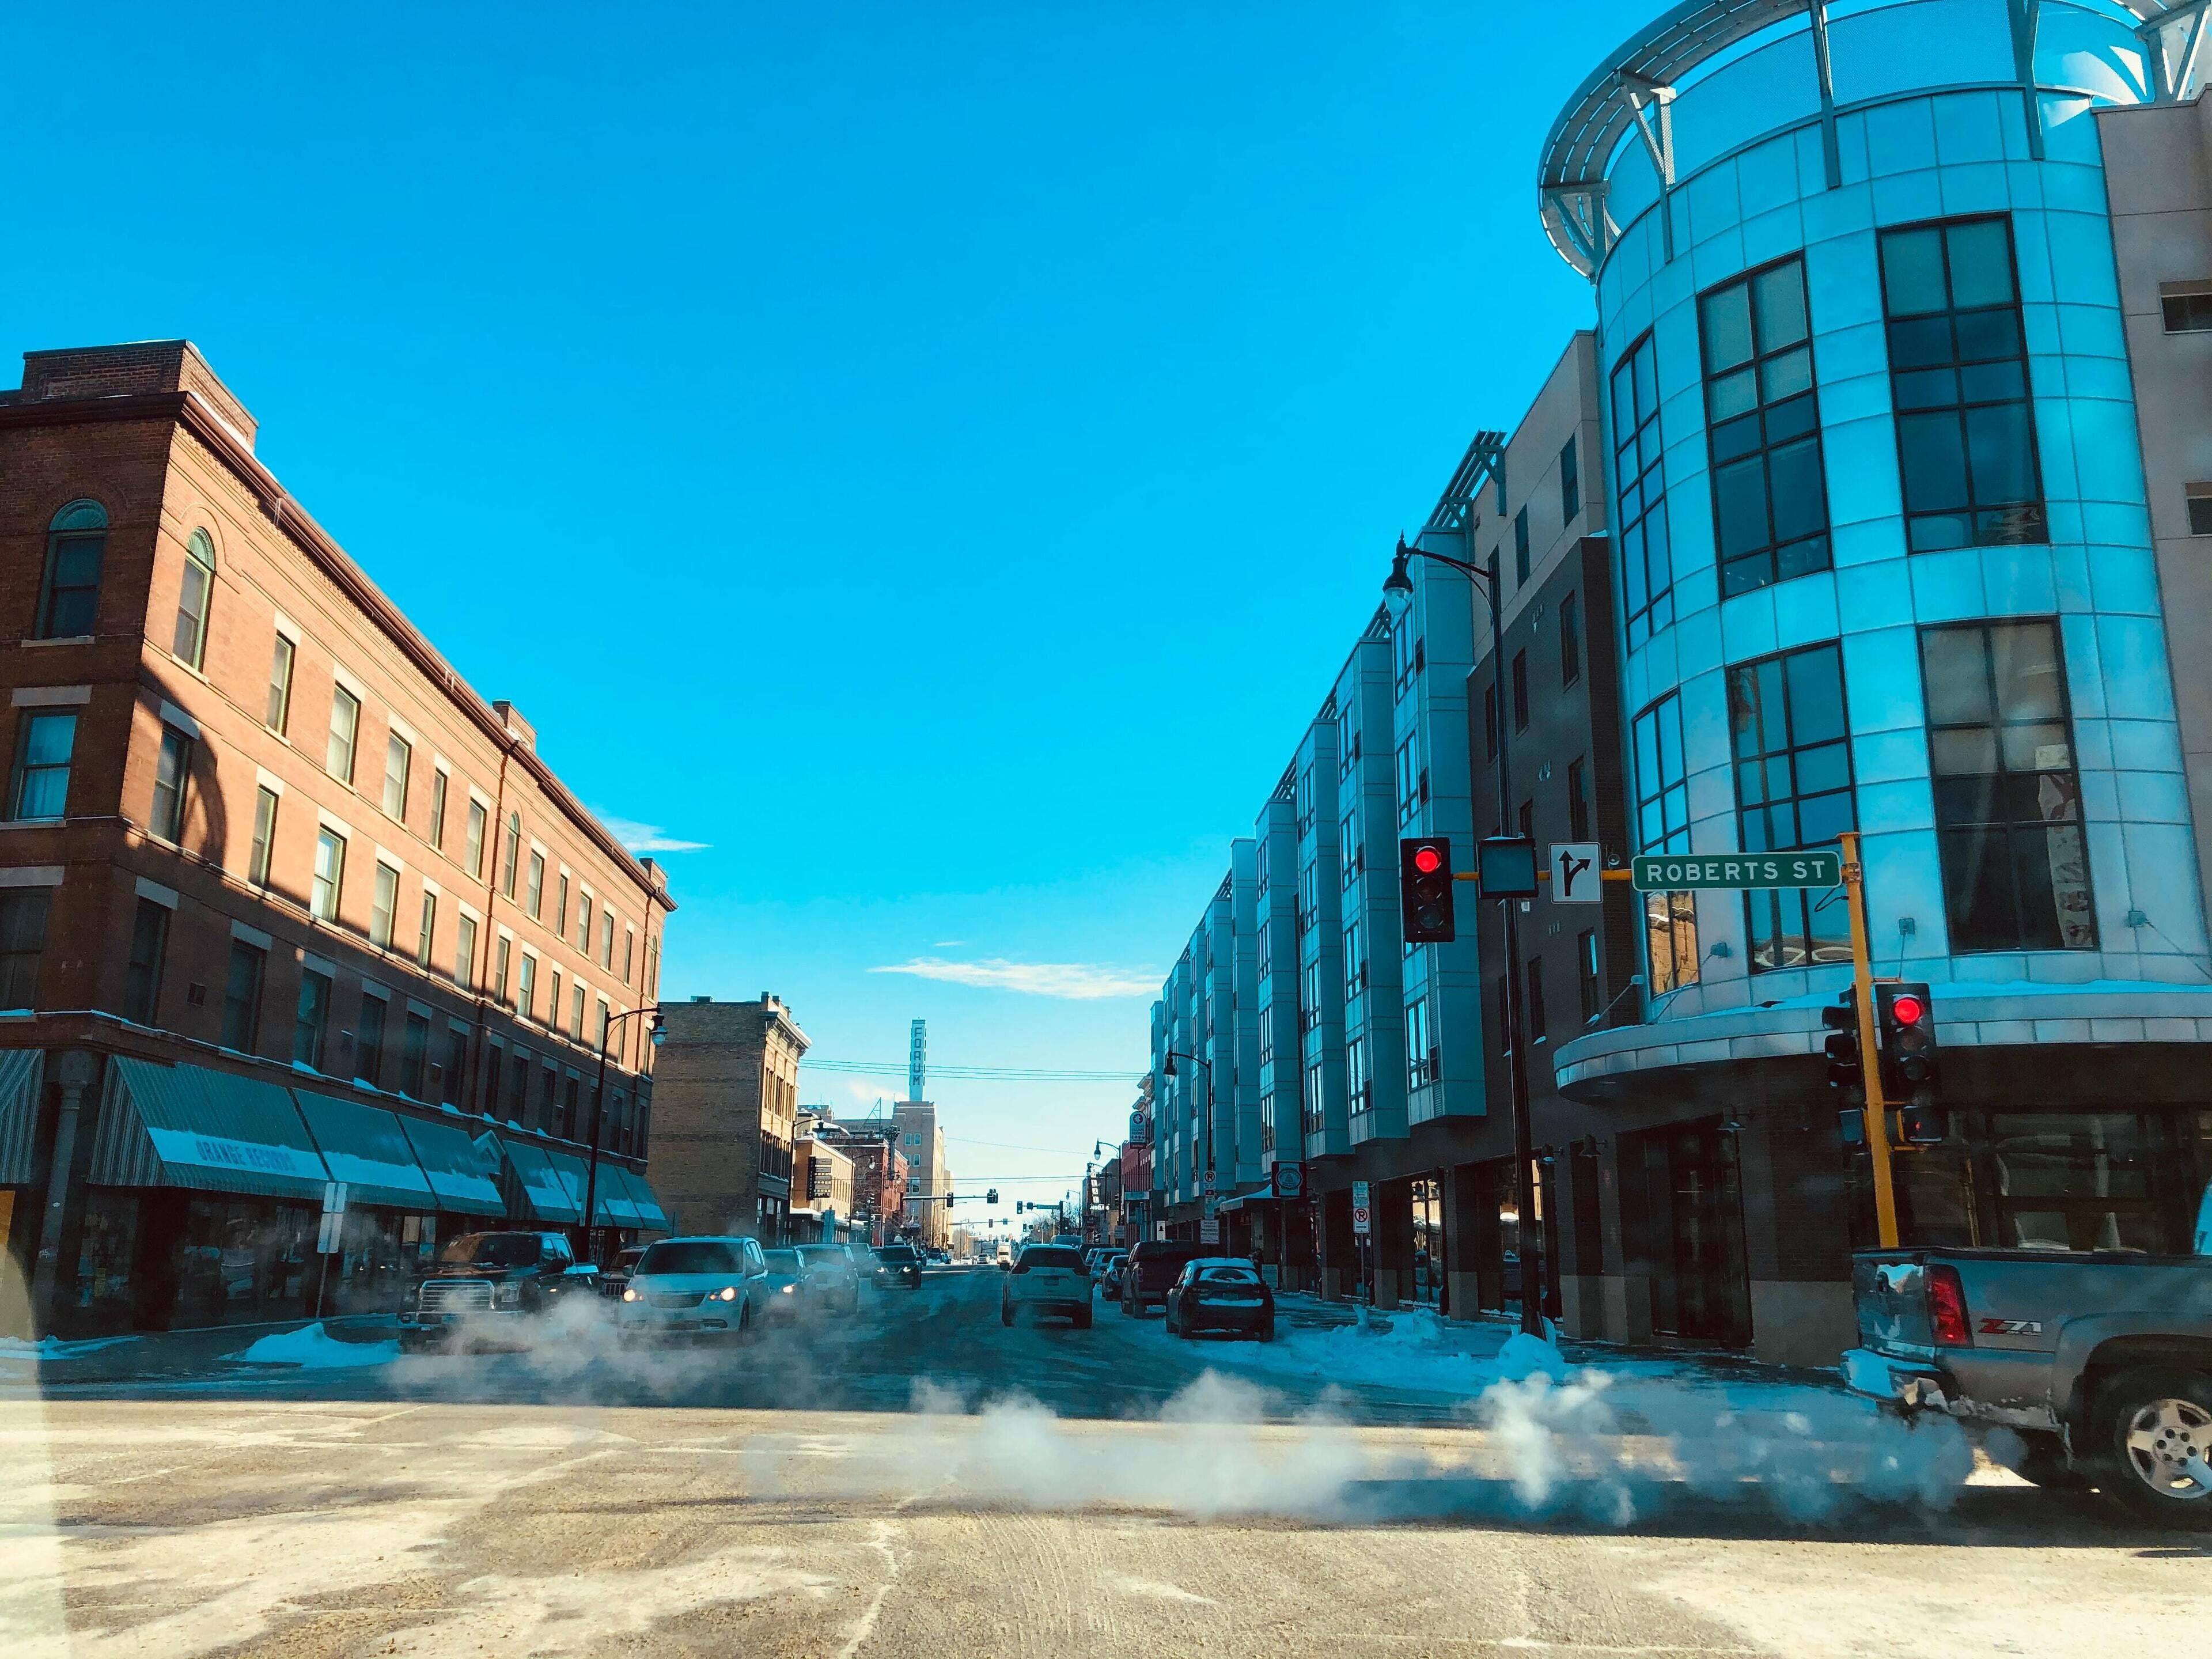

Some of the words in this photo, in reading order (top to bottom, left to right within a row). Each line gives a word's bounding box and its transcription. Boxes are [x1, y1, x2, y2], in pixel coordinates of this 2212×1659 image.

[1646, 861, 1778, 881] ROBERTS
[1793, 861, 1825, 879] ST
[912, 1027, 922, 1086] FORUM
[195, 1139, 247, 1165] ORANGE
[245, 1147, 296, 1172] RECORDS
[1979, 1318, 2043, 1334] Z71
